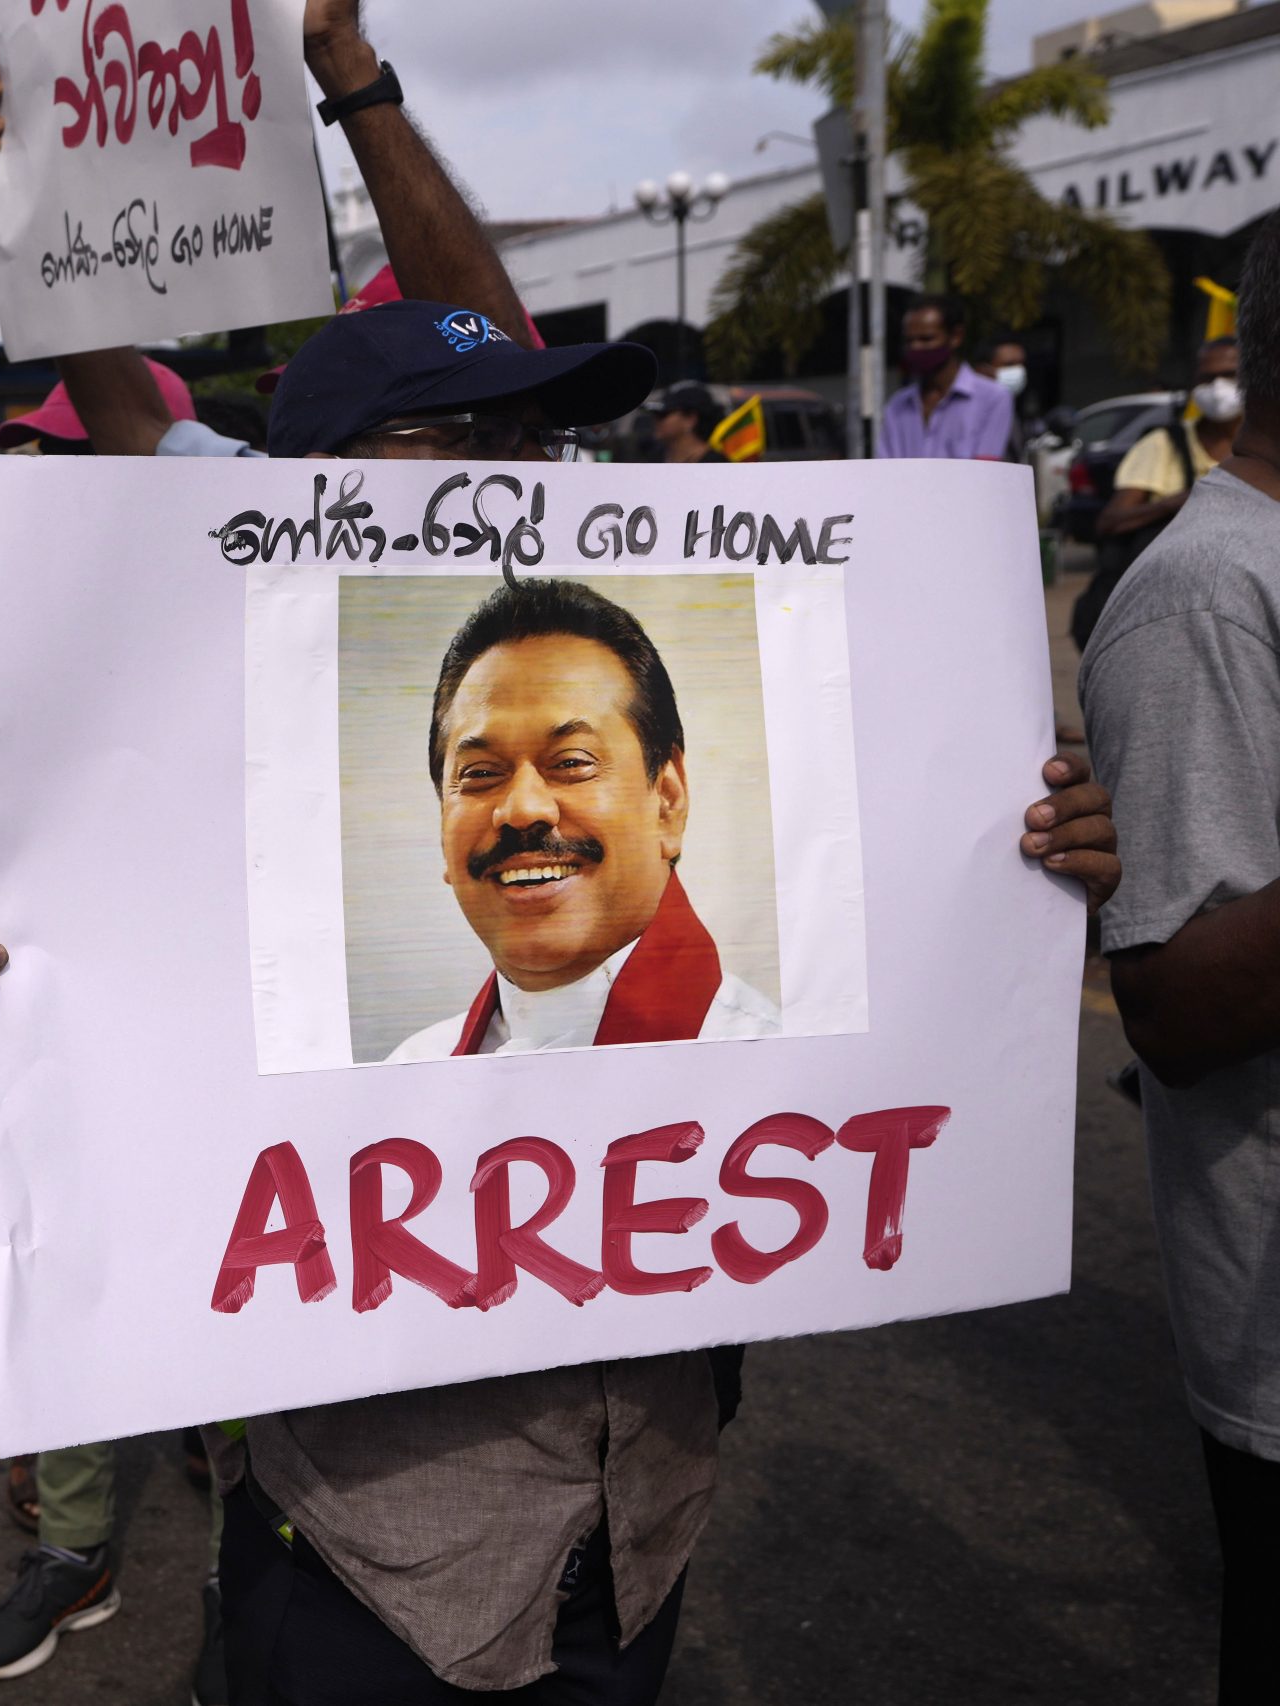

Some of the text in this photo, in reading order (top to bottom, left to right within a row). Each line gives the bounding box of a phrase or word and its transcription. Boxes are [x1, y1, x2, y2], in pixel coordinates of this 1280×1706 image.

[1061, 138, 1280, 210] AILWAY
[171, 224, 203, 266] GO
[213, 205, 274, 259] HOME
[577, 502, 658, 562] GO
[684, 504, 854, 565] HOME
[211, 1105, 952, 1314] ARREST
